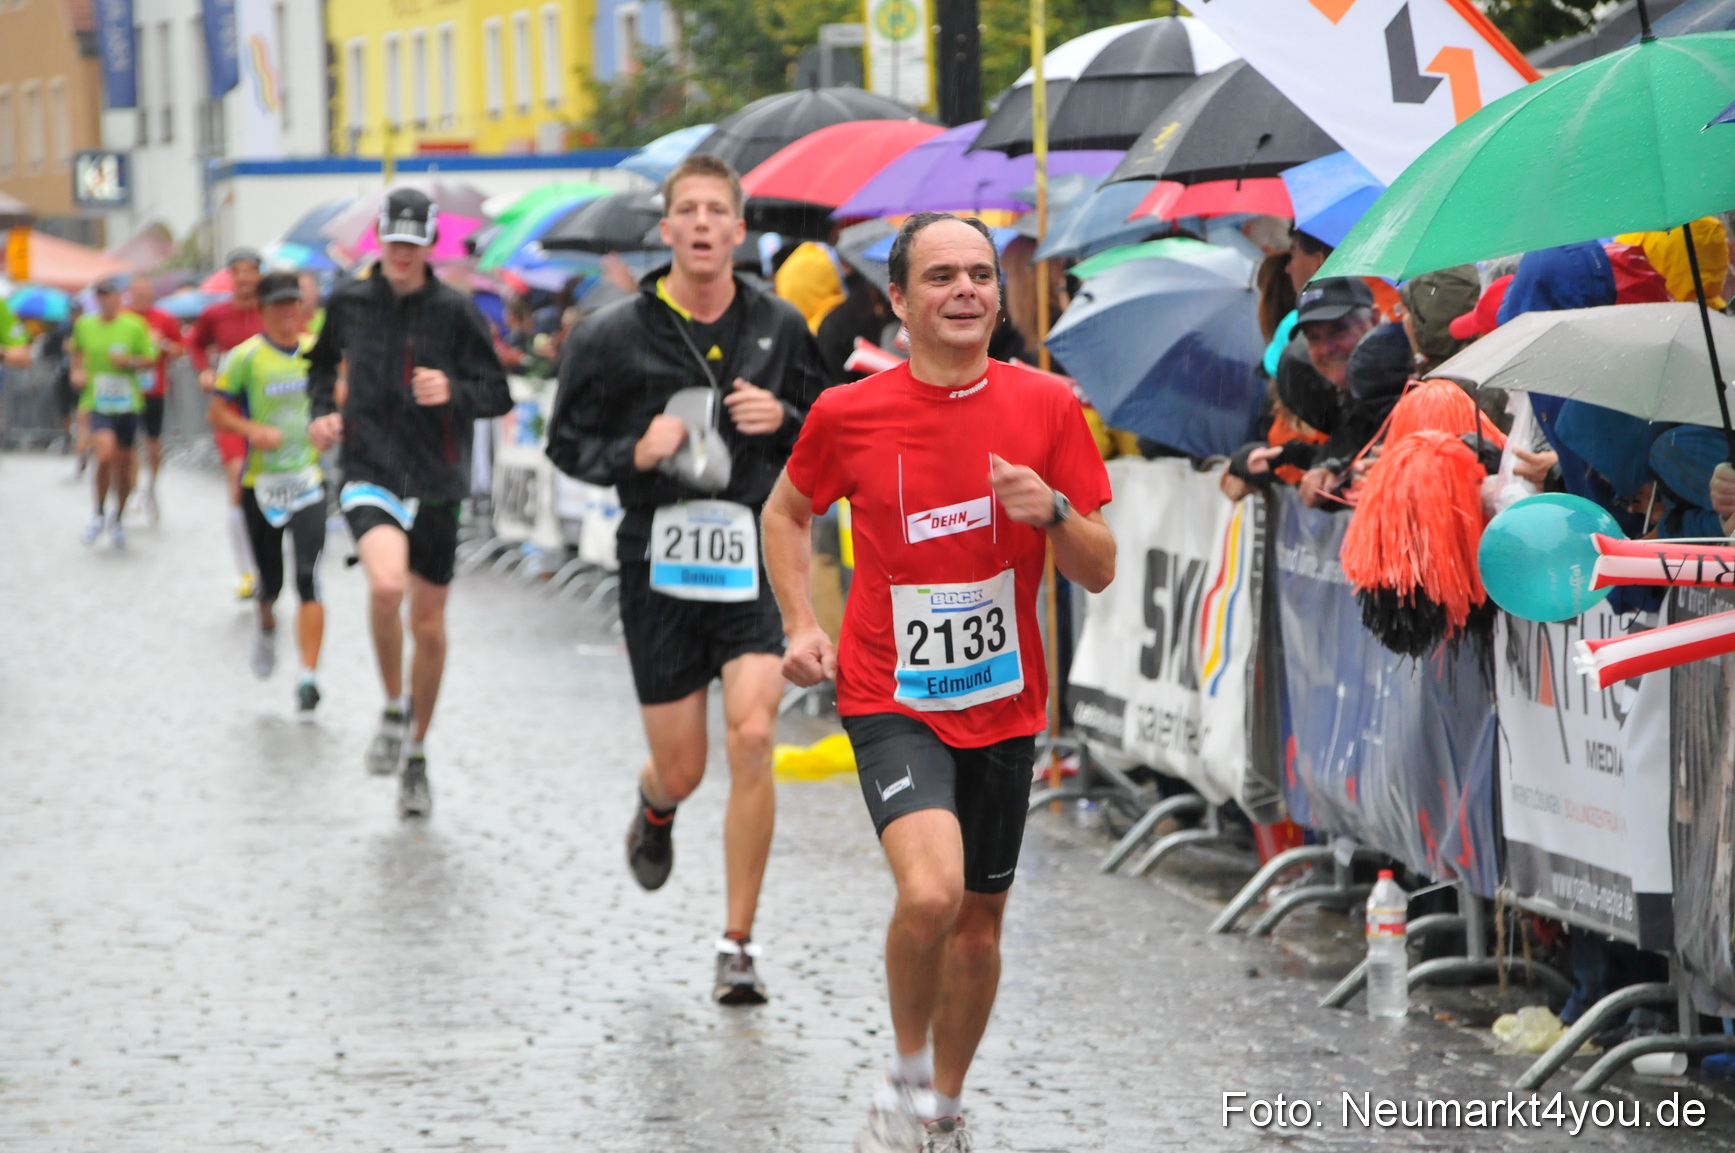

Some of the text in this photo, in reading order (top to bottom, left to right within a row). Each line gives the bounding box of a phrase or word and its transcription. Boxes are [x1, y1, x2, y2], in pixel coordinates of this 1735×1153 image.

[931, 511, 968, 530] DEHN
[664, 525, 744, 564] 2105
[931, 588, 984, 606] BOCK
[906, 606, 1006, 666] 2133
[927, 665, 993, 696] Edmund
